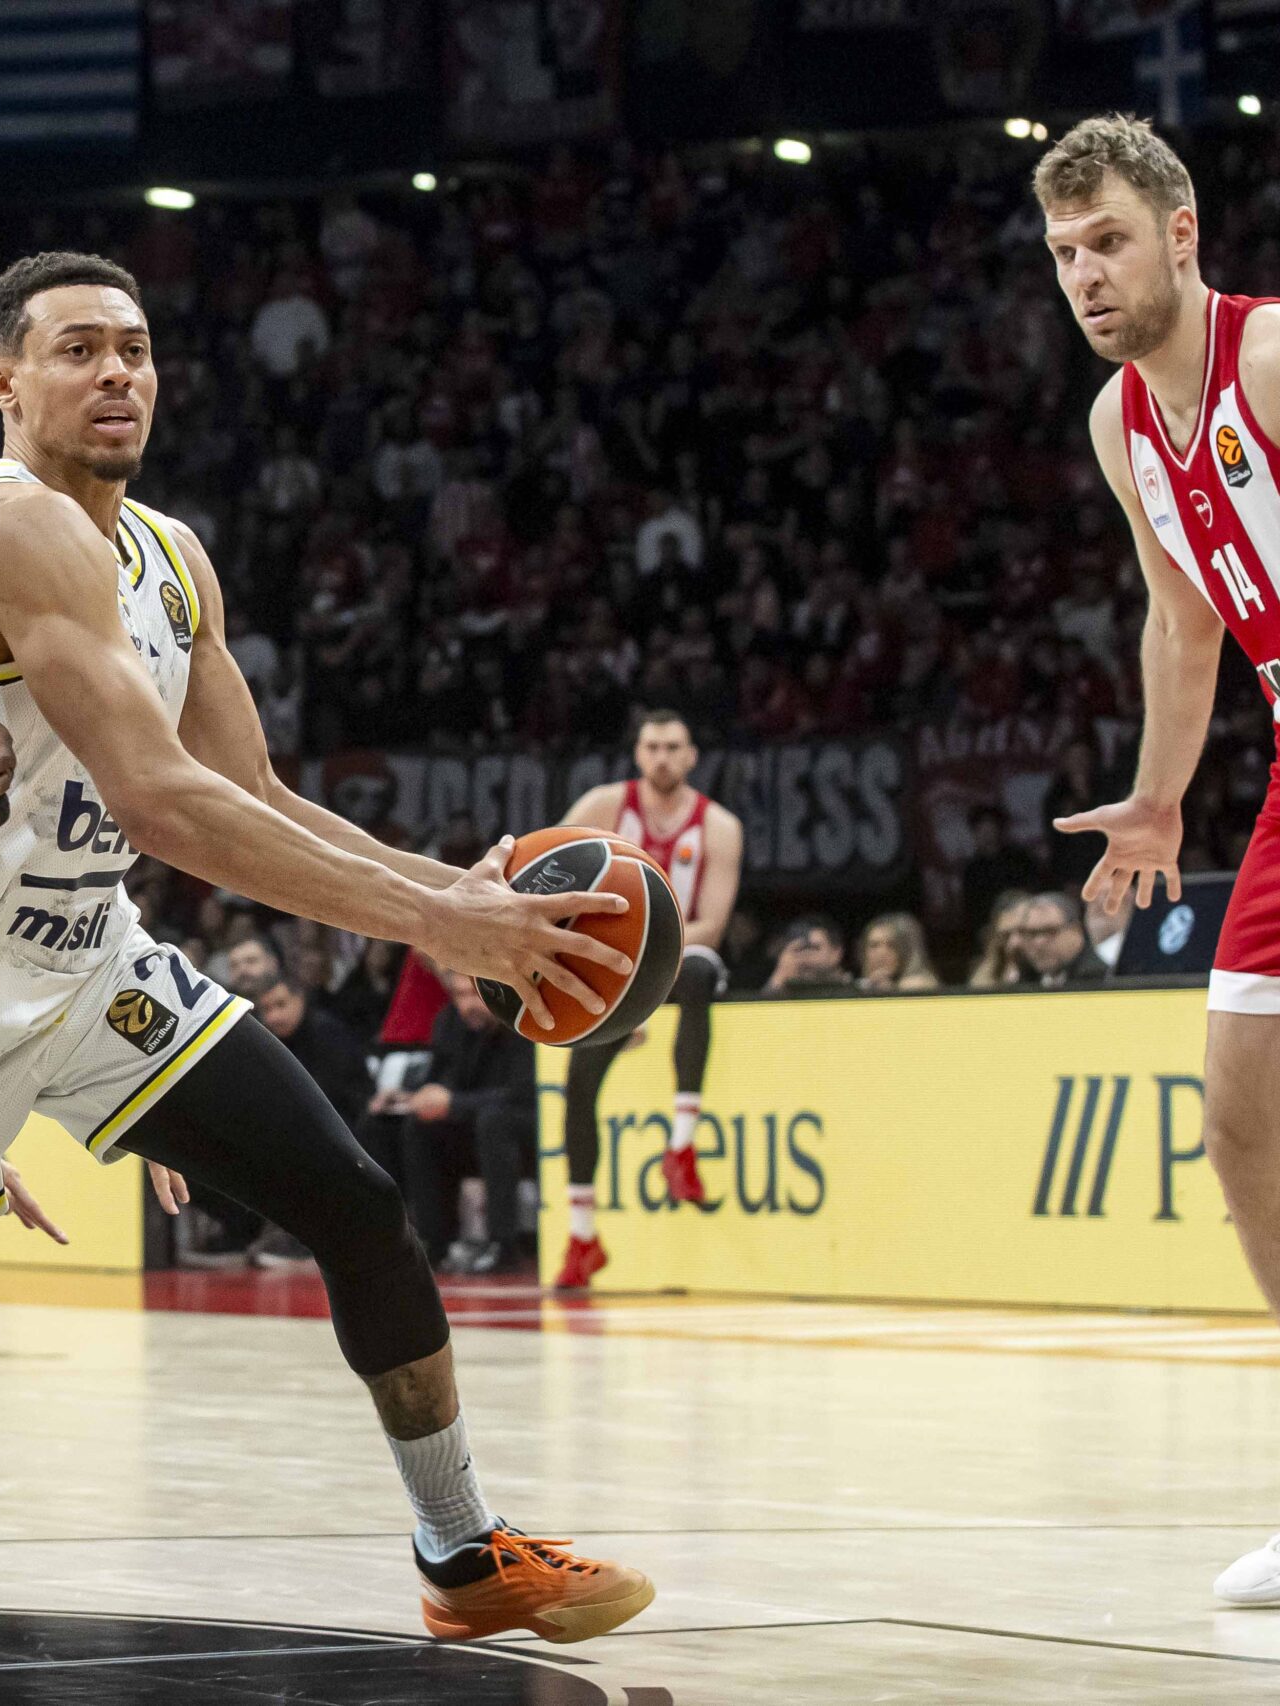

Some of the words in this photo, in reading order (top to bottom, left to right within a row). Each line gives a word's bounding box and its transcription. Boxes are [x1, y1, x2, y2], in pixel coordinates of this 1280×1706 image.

[1211, 542, 1266, 621] 14
[134, 952, 213, 1011] 2
[536, 1081, 826, 1215] raeus
